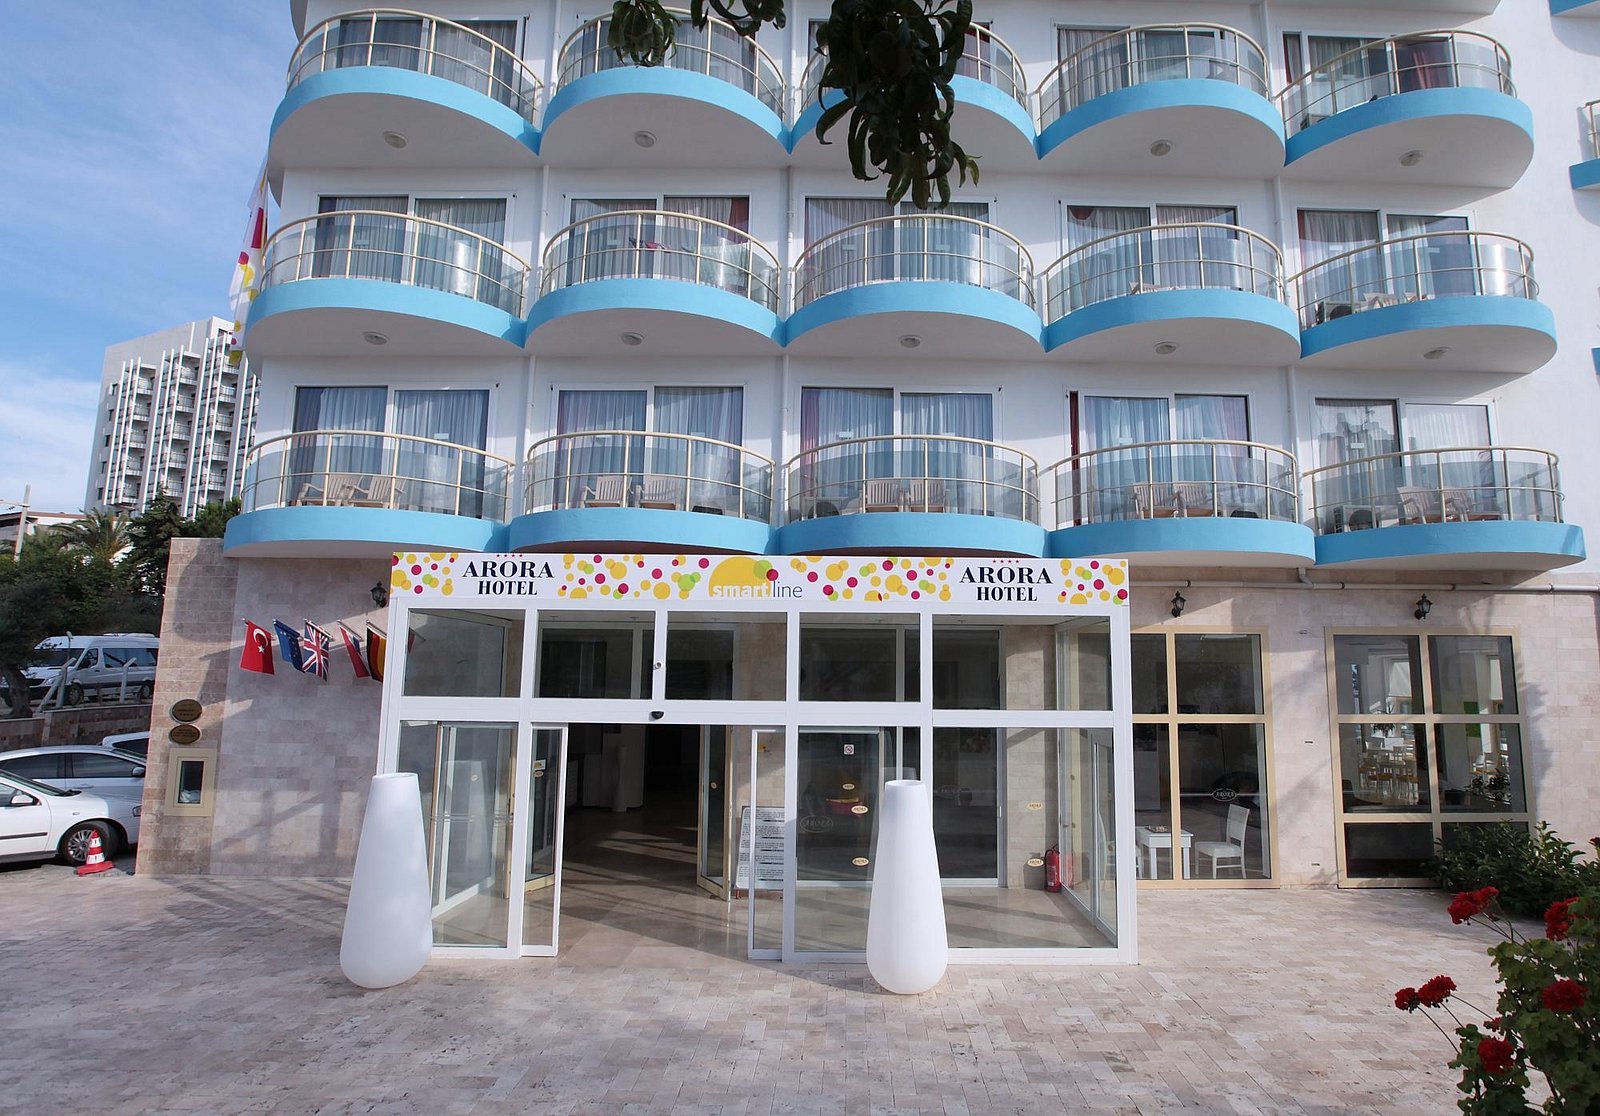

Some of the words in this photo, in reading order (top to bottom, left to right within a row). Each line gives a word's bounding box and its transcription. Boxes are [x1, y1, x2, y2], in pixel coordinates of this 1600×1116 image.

[462, 561, 555, 578] ARORA
[959, 566, 1053, 584] ARORA
[478, 580, 538, 595] HOTEL
[977, 586, 1038, 601] HOTEL
